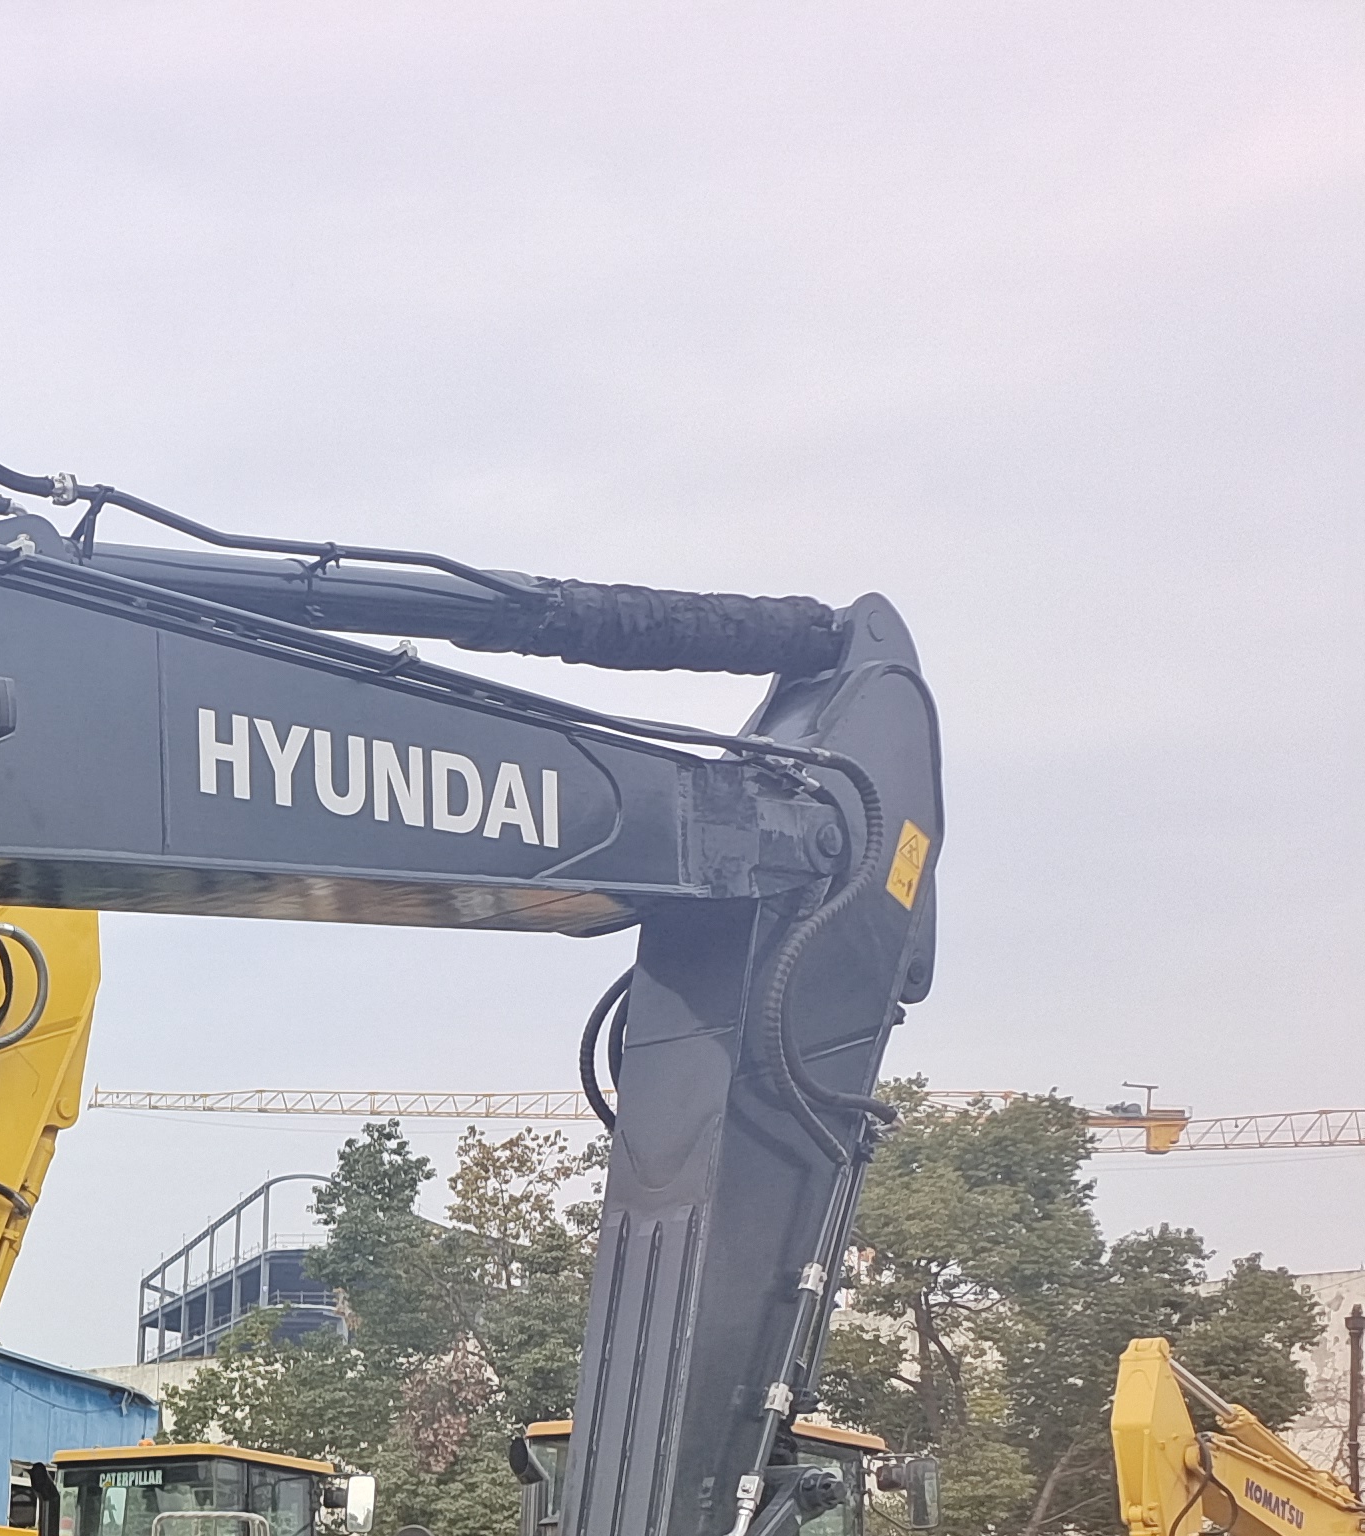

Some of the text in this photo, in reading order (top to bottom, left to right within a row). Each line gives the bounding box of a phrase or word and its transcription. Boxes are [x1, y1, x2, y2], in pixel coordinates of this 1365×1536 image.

[198, 707, 559, 849] HYUNDAI
[99, 1470, 163, 1488] CATERPILLAR
[1244, 1477, 1305, 1530] KOMATSU
